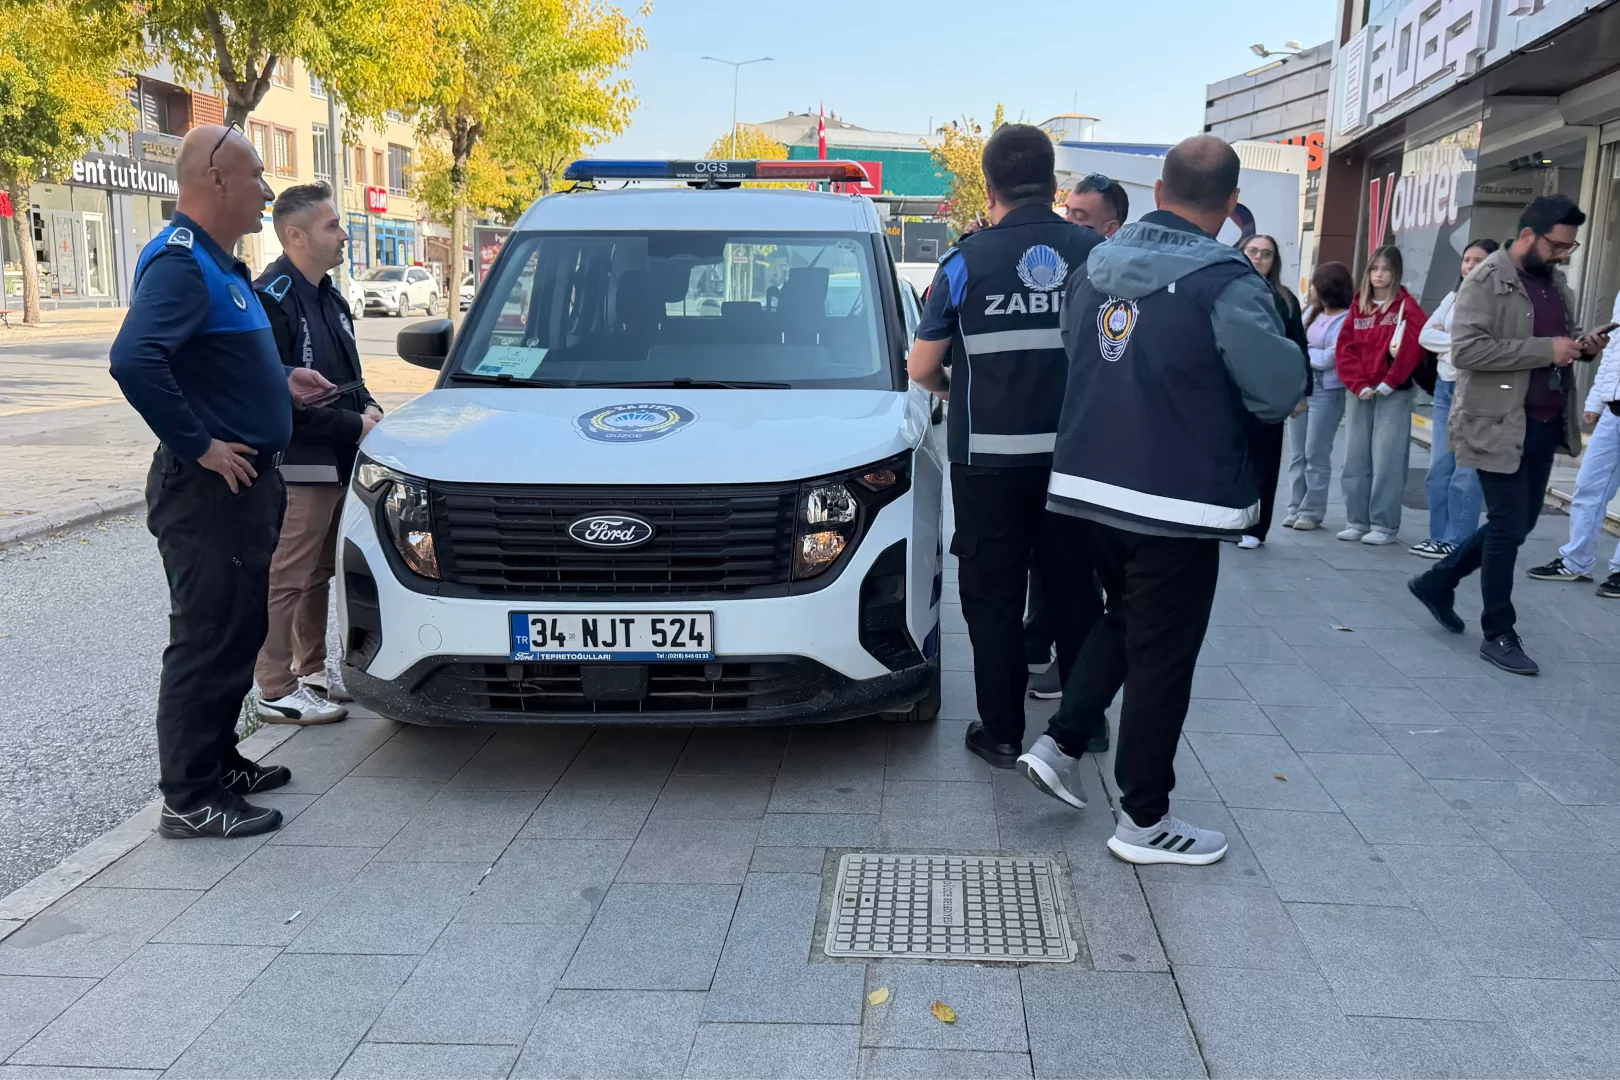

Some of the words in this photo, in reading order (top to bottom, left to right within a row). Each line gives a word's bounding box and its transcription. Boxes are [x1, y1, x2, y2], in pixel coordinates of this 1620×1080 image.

[109, 160, 167, 193] tutkun
[694, 162, 728, 173] OGS
[585, 520, 635, 541] Ford
[516, 635, 529, 645] TR
[531, 618, 566, 648] 34
[582, 618, 635, 648] NJT
[651, 618, 704, 648] 524
